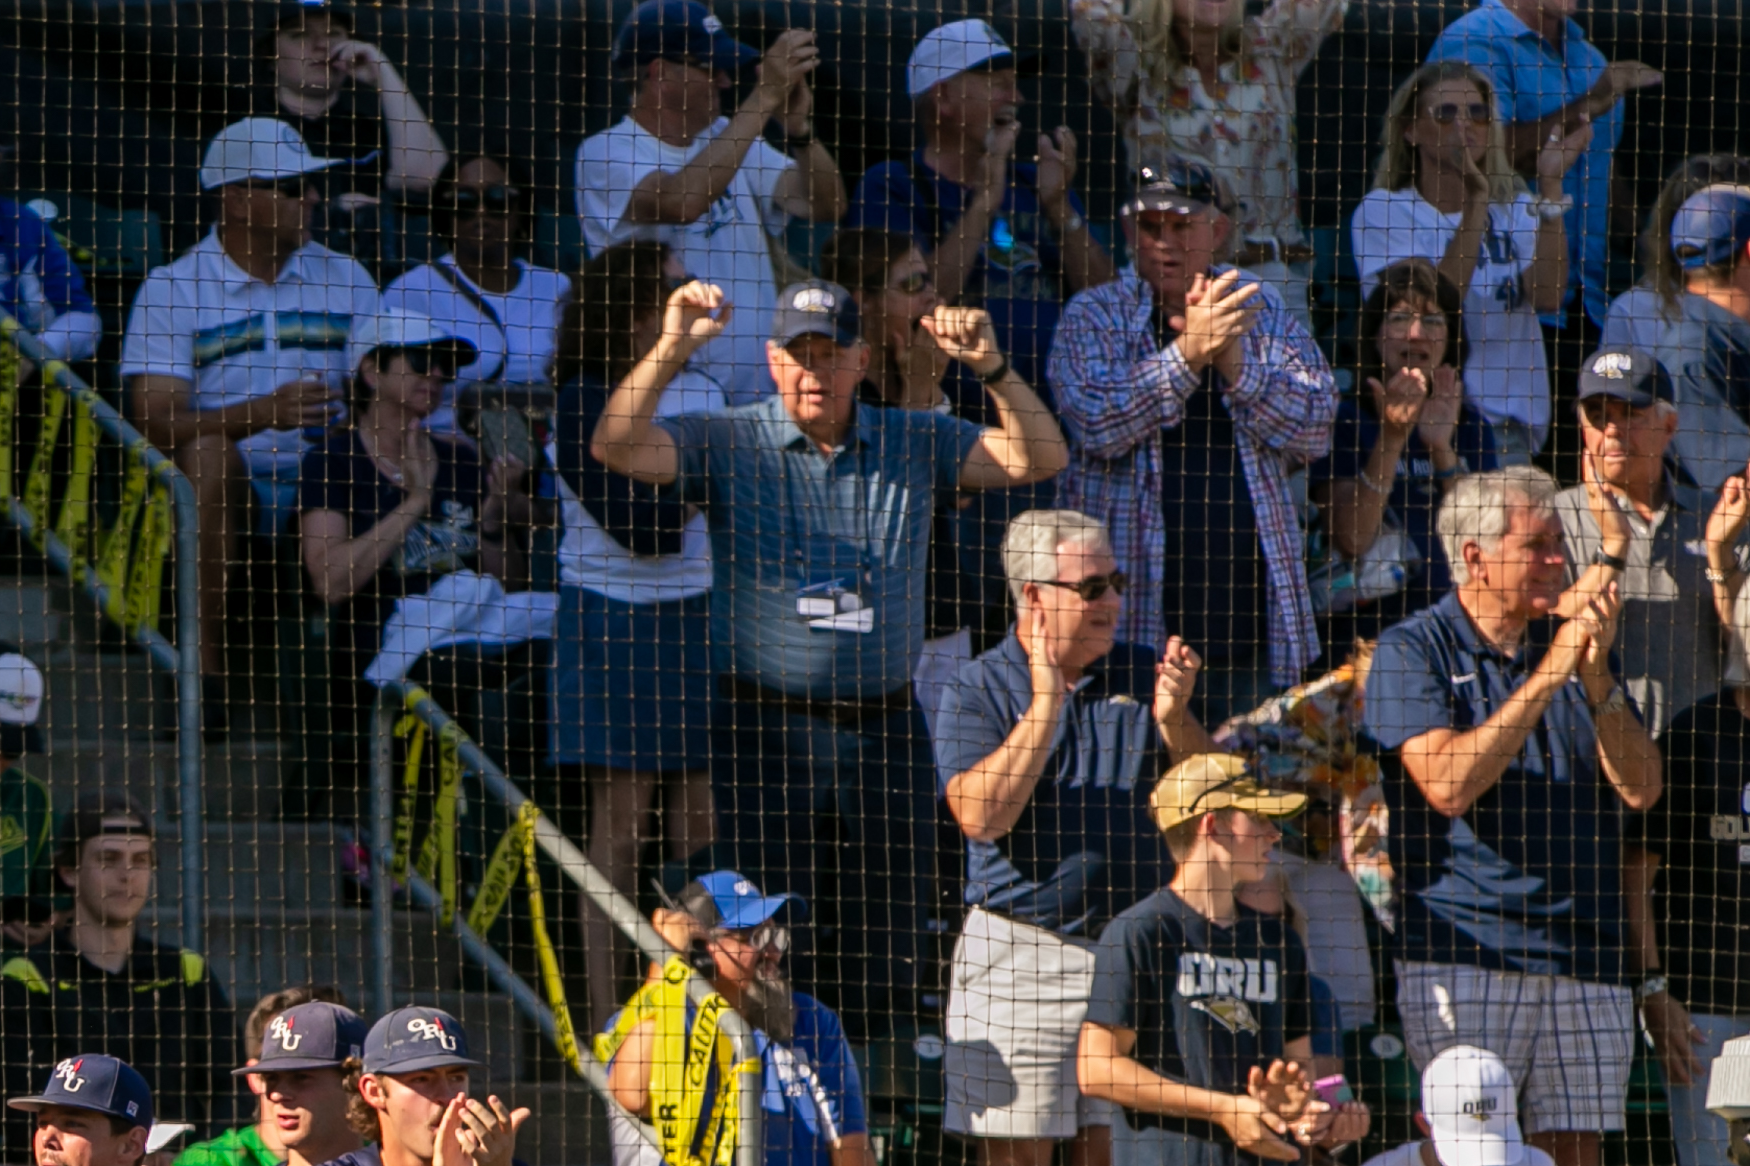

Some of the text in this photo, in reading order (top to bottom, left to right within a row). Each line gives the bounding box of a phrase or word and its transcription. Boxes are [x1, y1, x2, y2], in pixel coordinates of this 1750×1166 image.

[1177, 952, 1279, 1003] ORU
[268, 1014, 302, 1051] ORU
[407, 1017, 458, 1051] ORU
